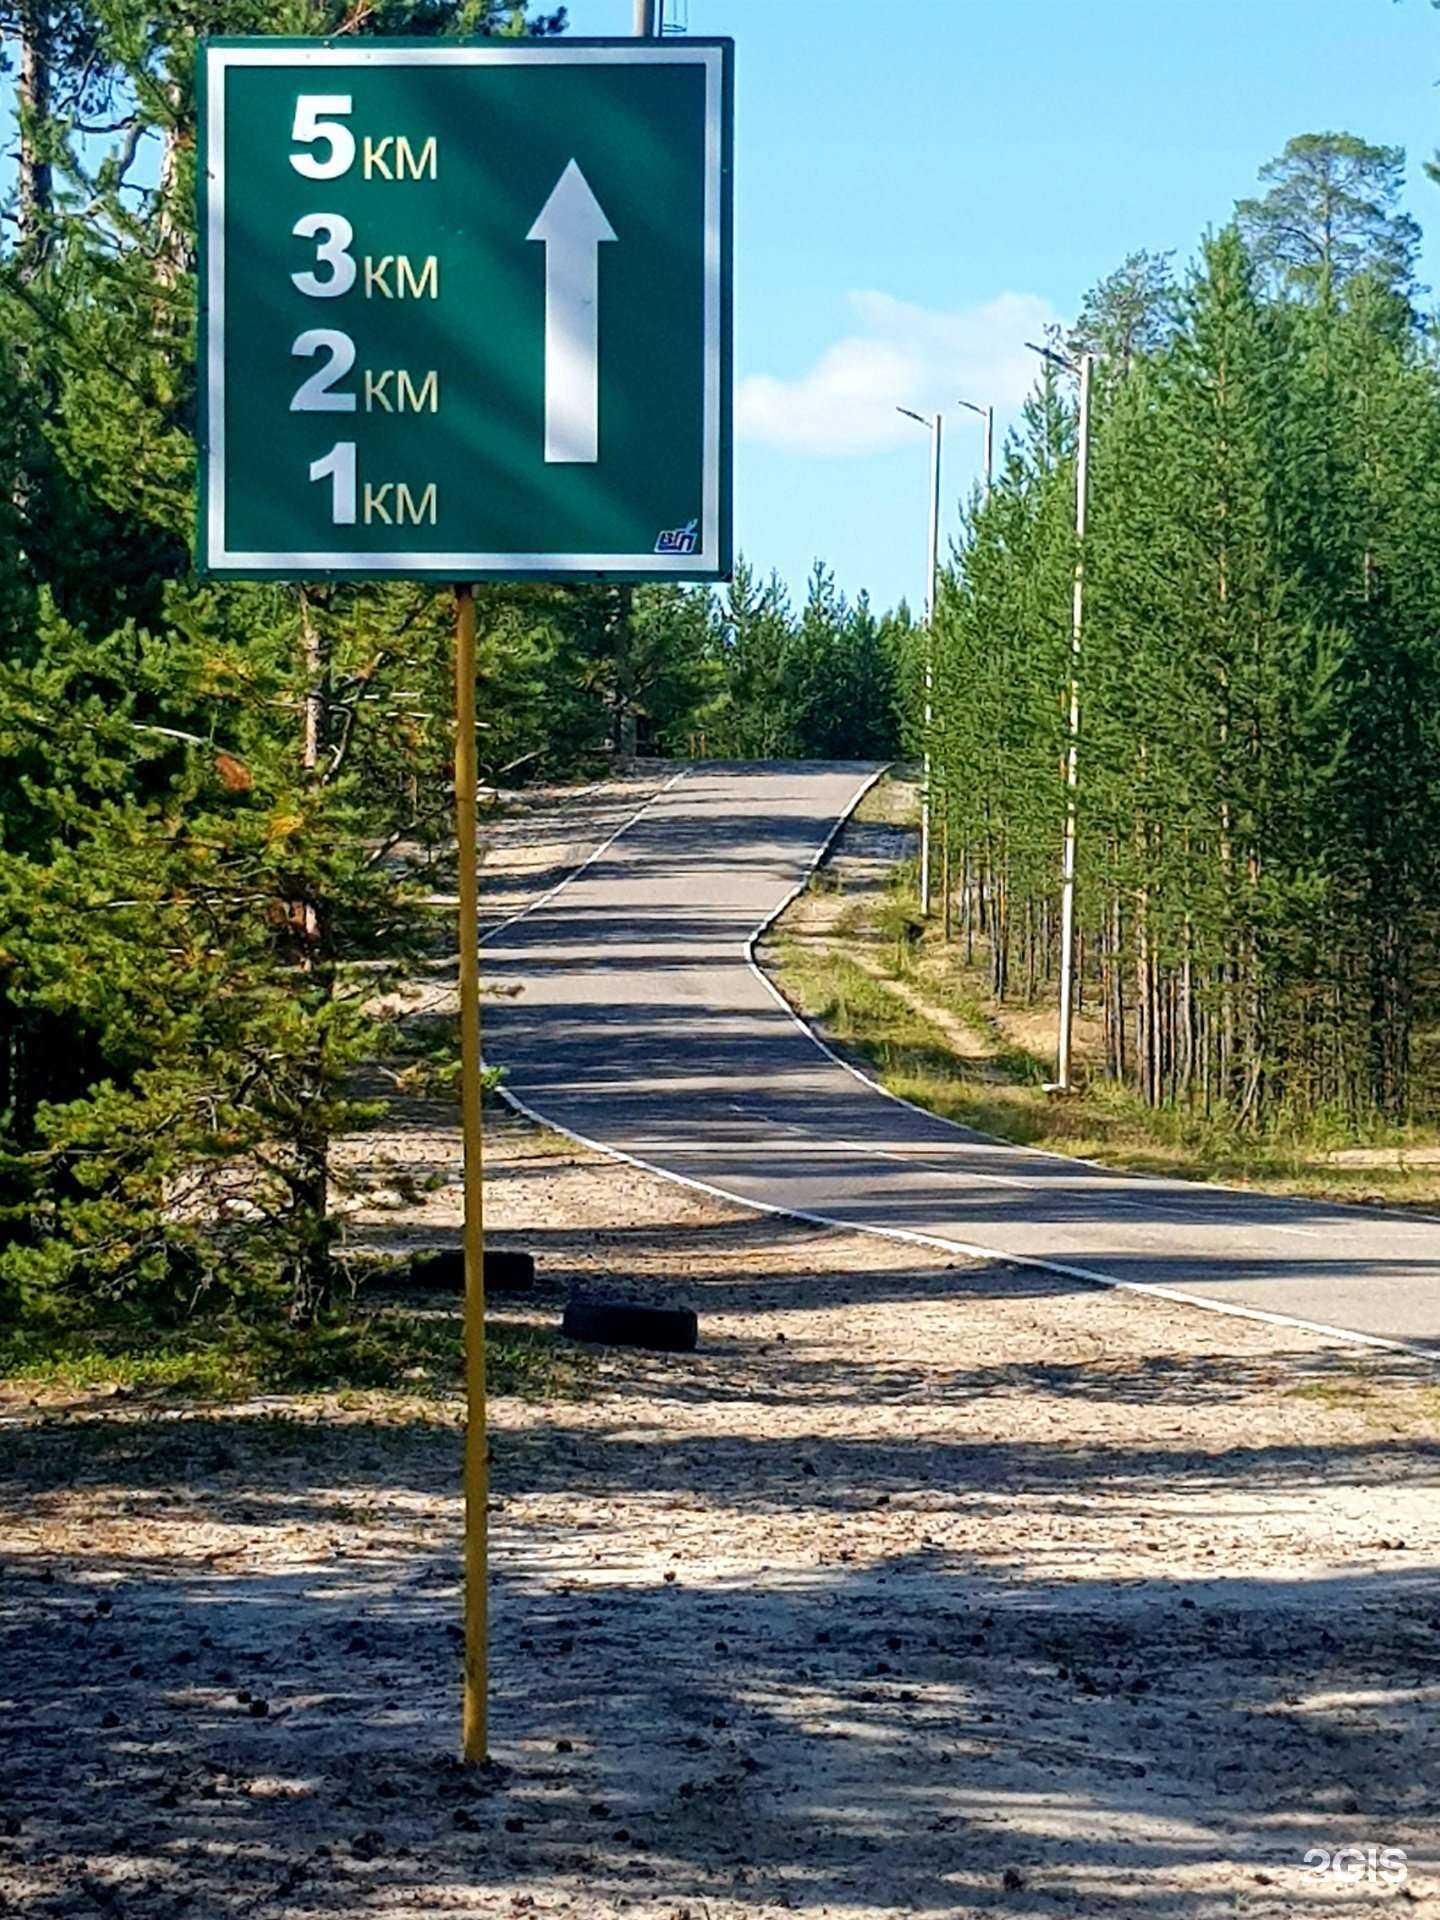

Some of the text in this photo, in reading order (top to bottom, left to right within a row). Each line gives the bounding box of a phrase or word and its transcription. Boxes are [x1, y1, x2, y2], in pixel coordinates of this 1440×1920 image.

[289, 95, 355, 179] 5
[291, 213, 357, 297] 3
[289, 328, 356, 411] 2
[310, 442, 356, 524] 1
